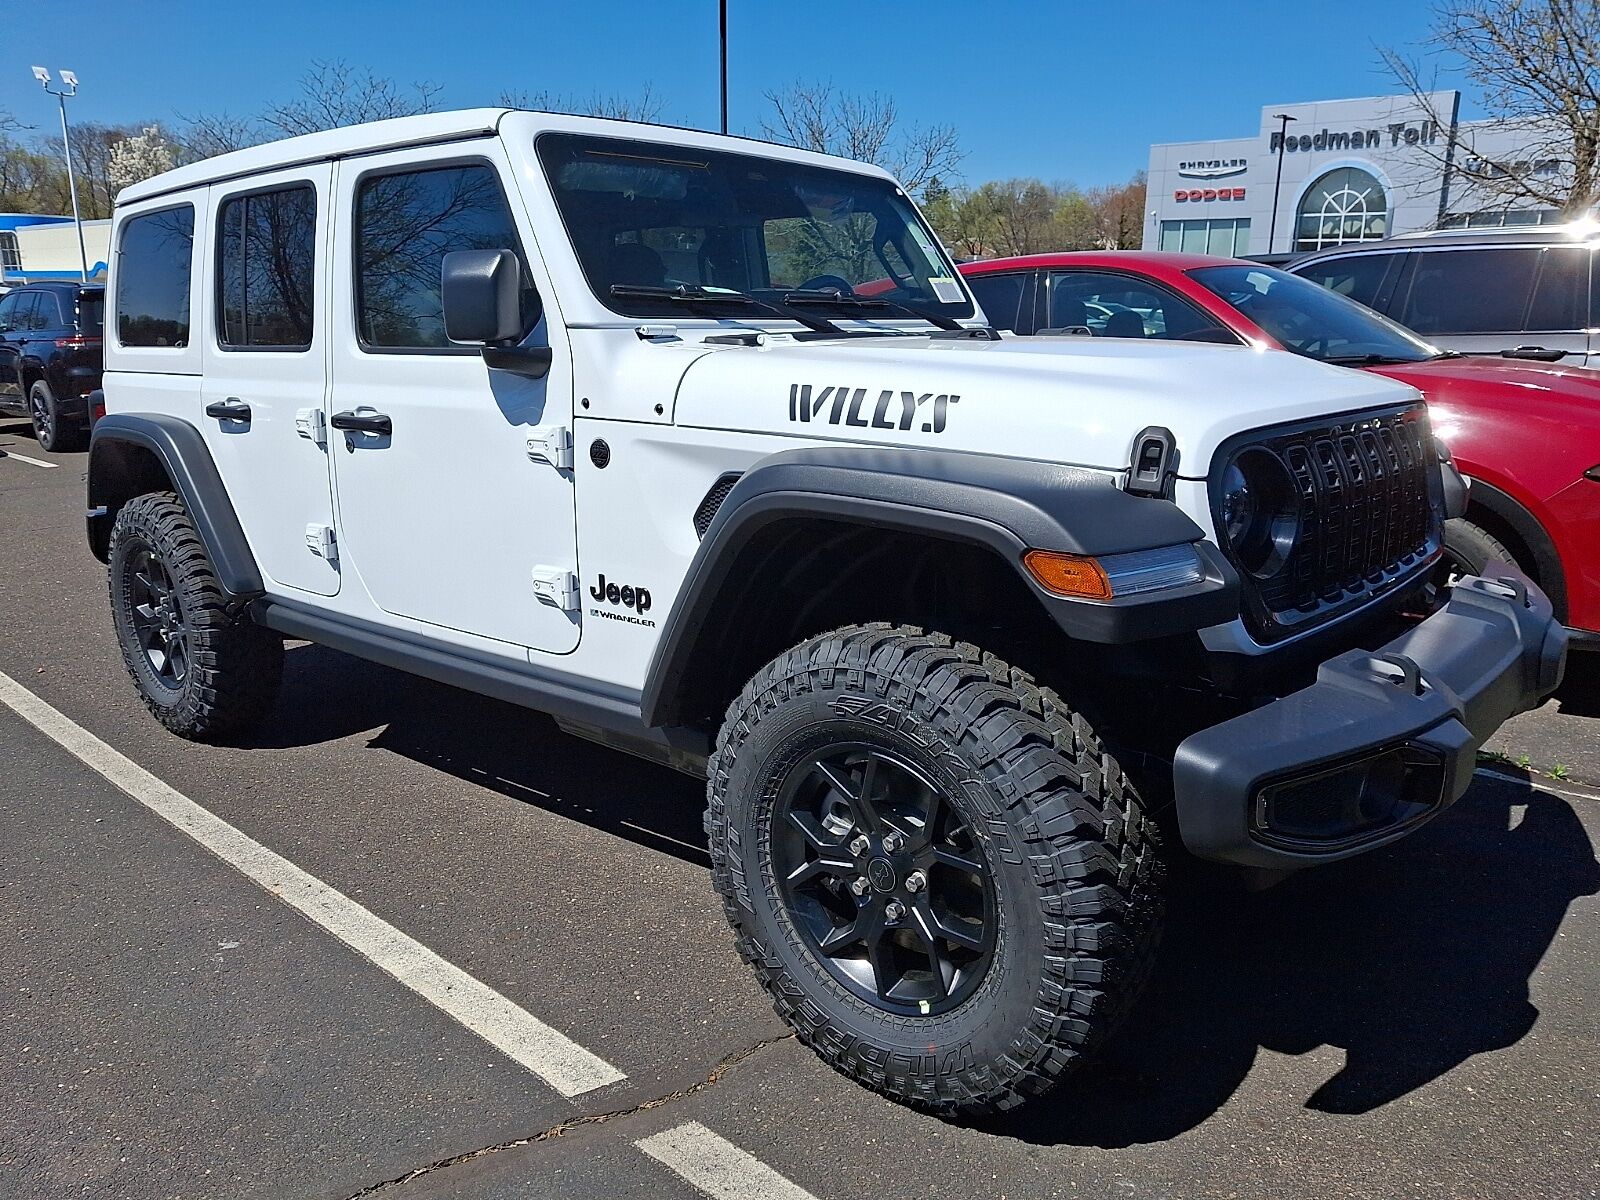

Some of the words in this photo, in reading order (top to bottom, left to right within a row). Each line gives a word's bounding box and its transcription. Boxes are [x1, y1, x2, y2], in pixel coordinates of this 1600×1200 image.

[1270, 129, 1380, 153] Reedman
[1388, 121, 1436, 147] Toll
[1175, 187, 1246, 203] DODGE
[789, 383, 960, 433] WILLYS
[589, 574, 652, 615] Jeep
[599, 610, 656, 628] WRANGLER
[827, 694, 1023, 865] FALKEN
[750, 938, 976, 1078] WILDPEAK
